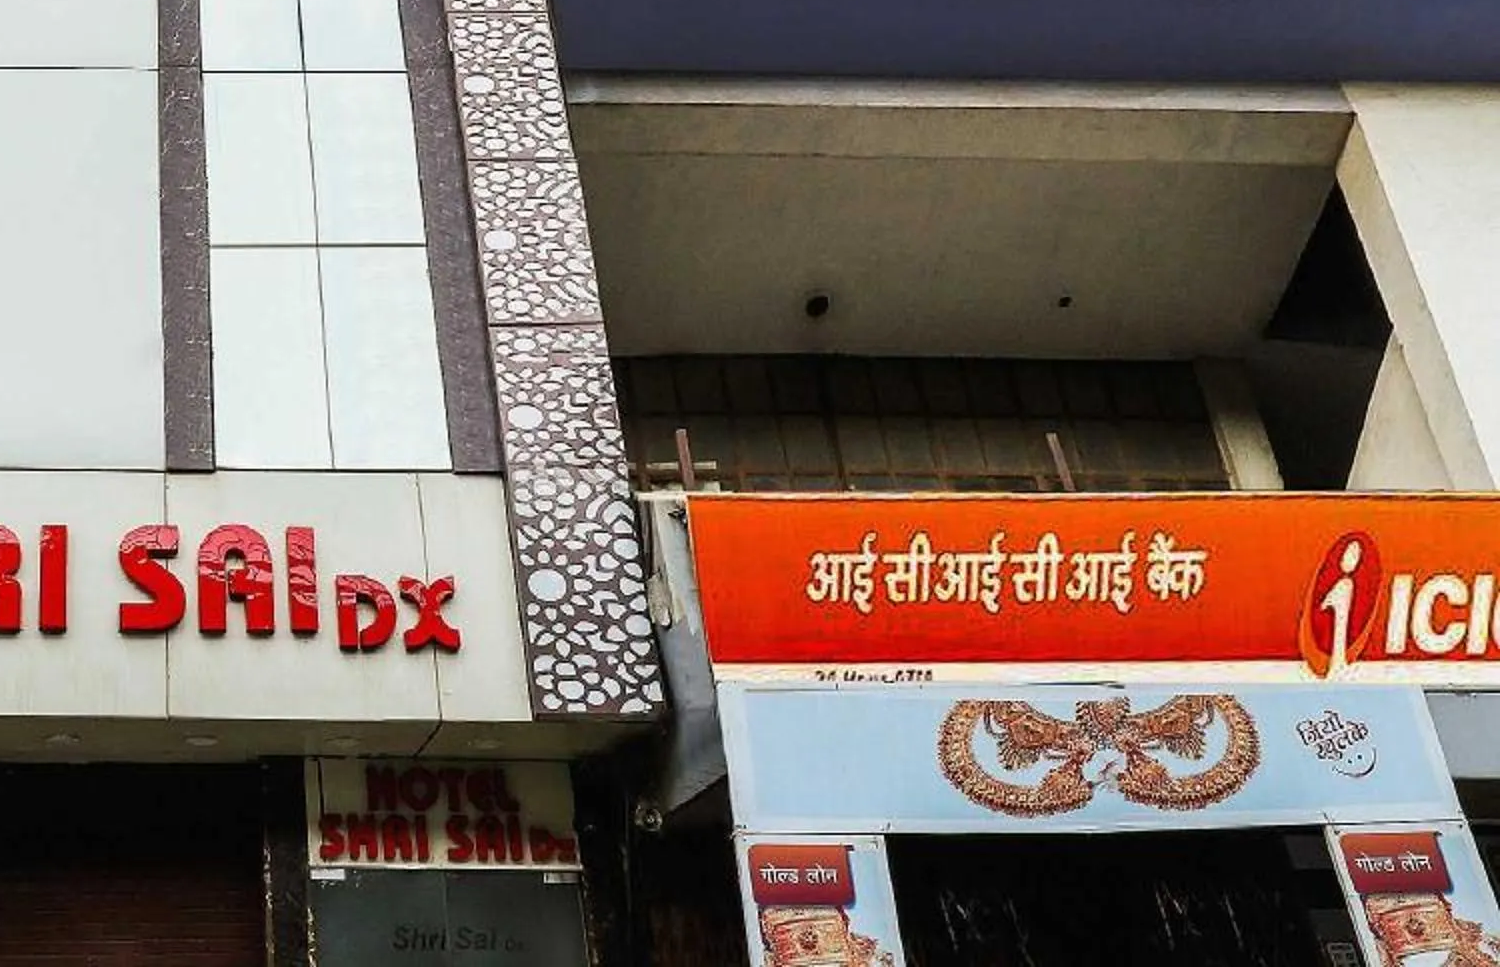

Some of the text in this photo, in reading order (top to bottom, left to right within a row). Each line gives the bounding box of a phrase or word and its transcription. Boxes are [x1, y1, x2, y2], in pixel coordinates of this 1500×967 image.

[117, 522, 320, 637] SAI
[335, 573, 462, 653] DX
[1145, 529, 1210, 604] बैंक
[1385, 572, 1500, 655] ICI
[365, 764, 520, 812] HOTEL
[318, 813, 430, 862] SHRI
[445, 813, 525, 863] SAI
[804, 863, 838, 885] लोन
[393, 924, 447, 952] Shri
[454, 924, 498, 952] Sai
